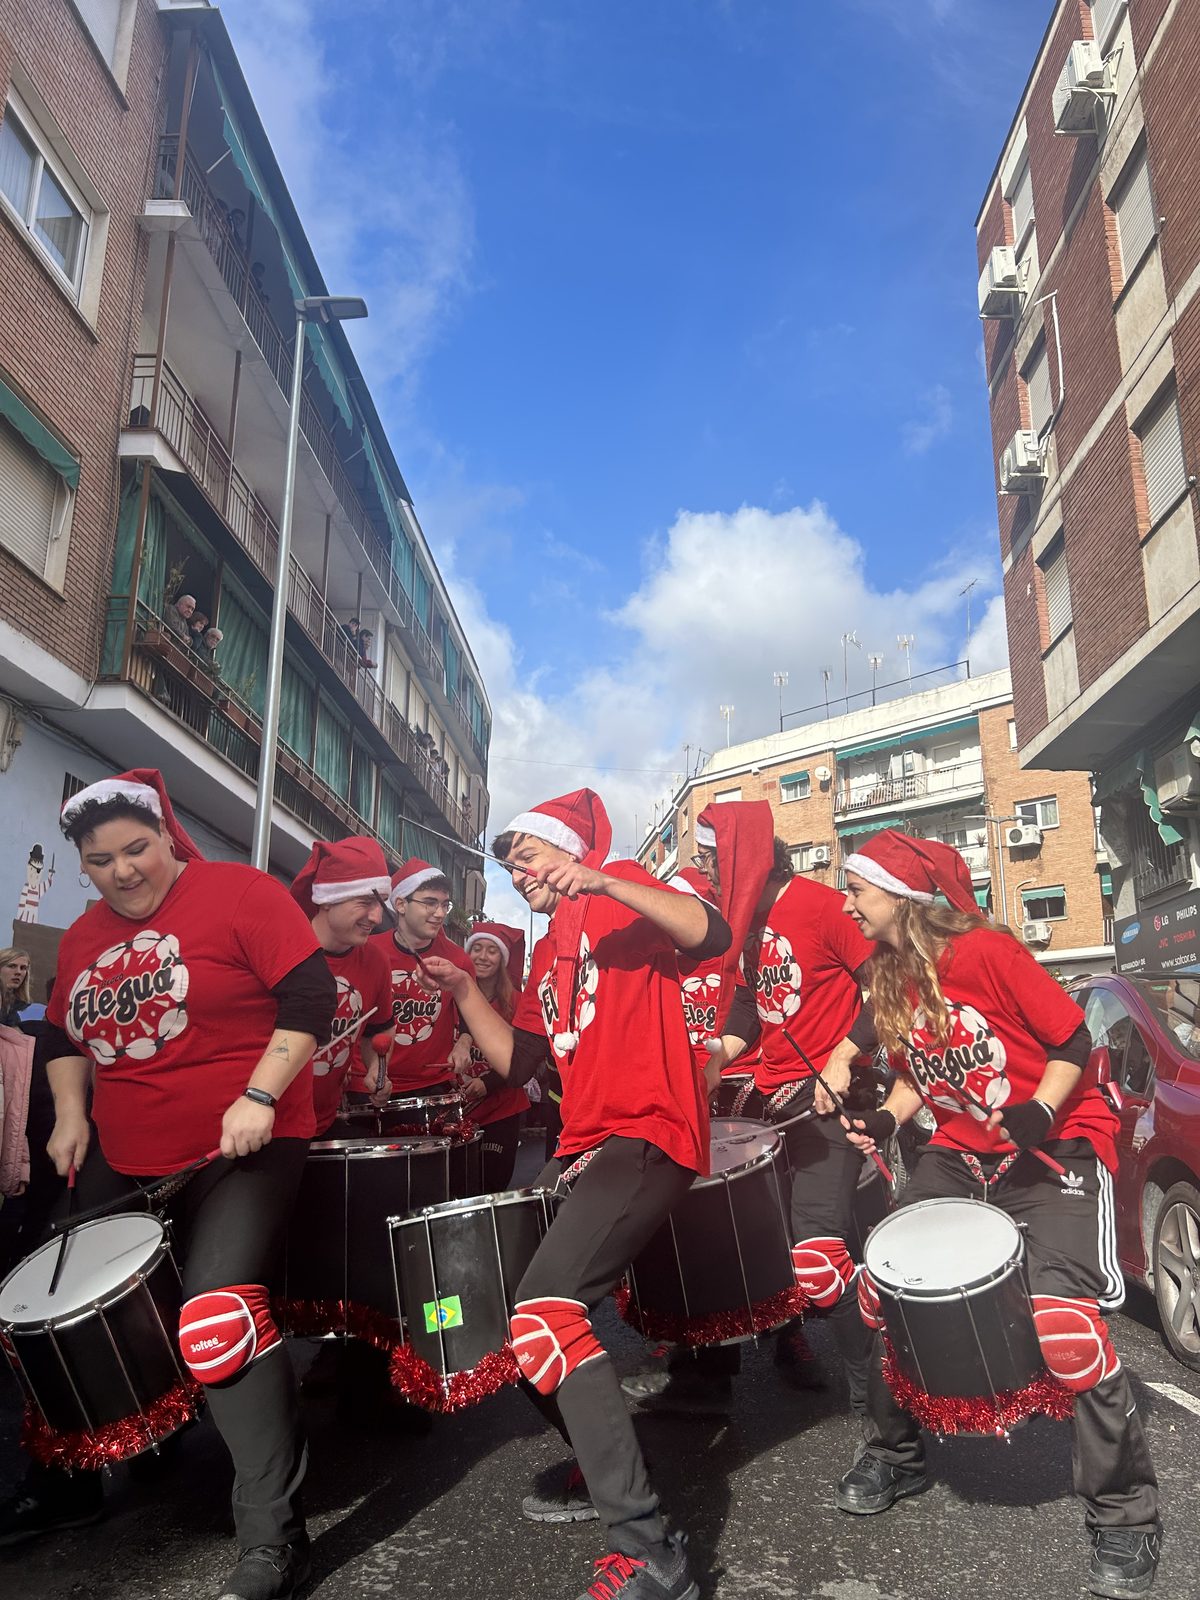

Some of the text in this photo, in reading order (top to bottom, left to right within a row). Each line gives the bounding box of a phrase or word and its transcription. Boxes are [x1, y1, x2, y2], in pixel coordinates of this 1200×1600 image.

[1176, 904, 1198, 921] PHILIPS
[1173, 930, 1196, 943] TOSHIBA
[73, 956, 175, 1030] Eleguá
[392, 995, 437, 1024] eguá
[1060, 1187, 1085, 1196] adidas
[190, 1336, 220, 1353] Softee
